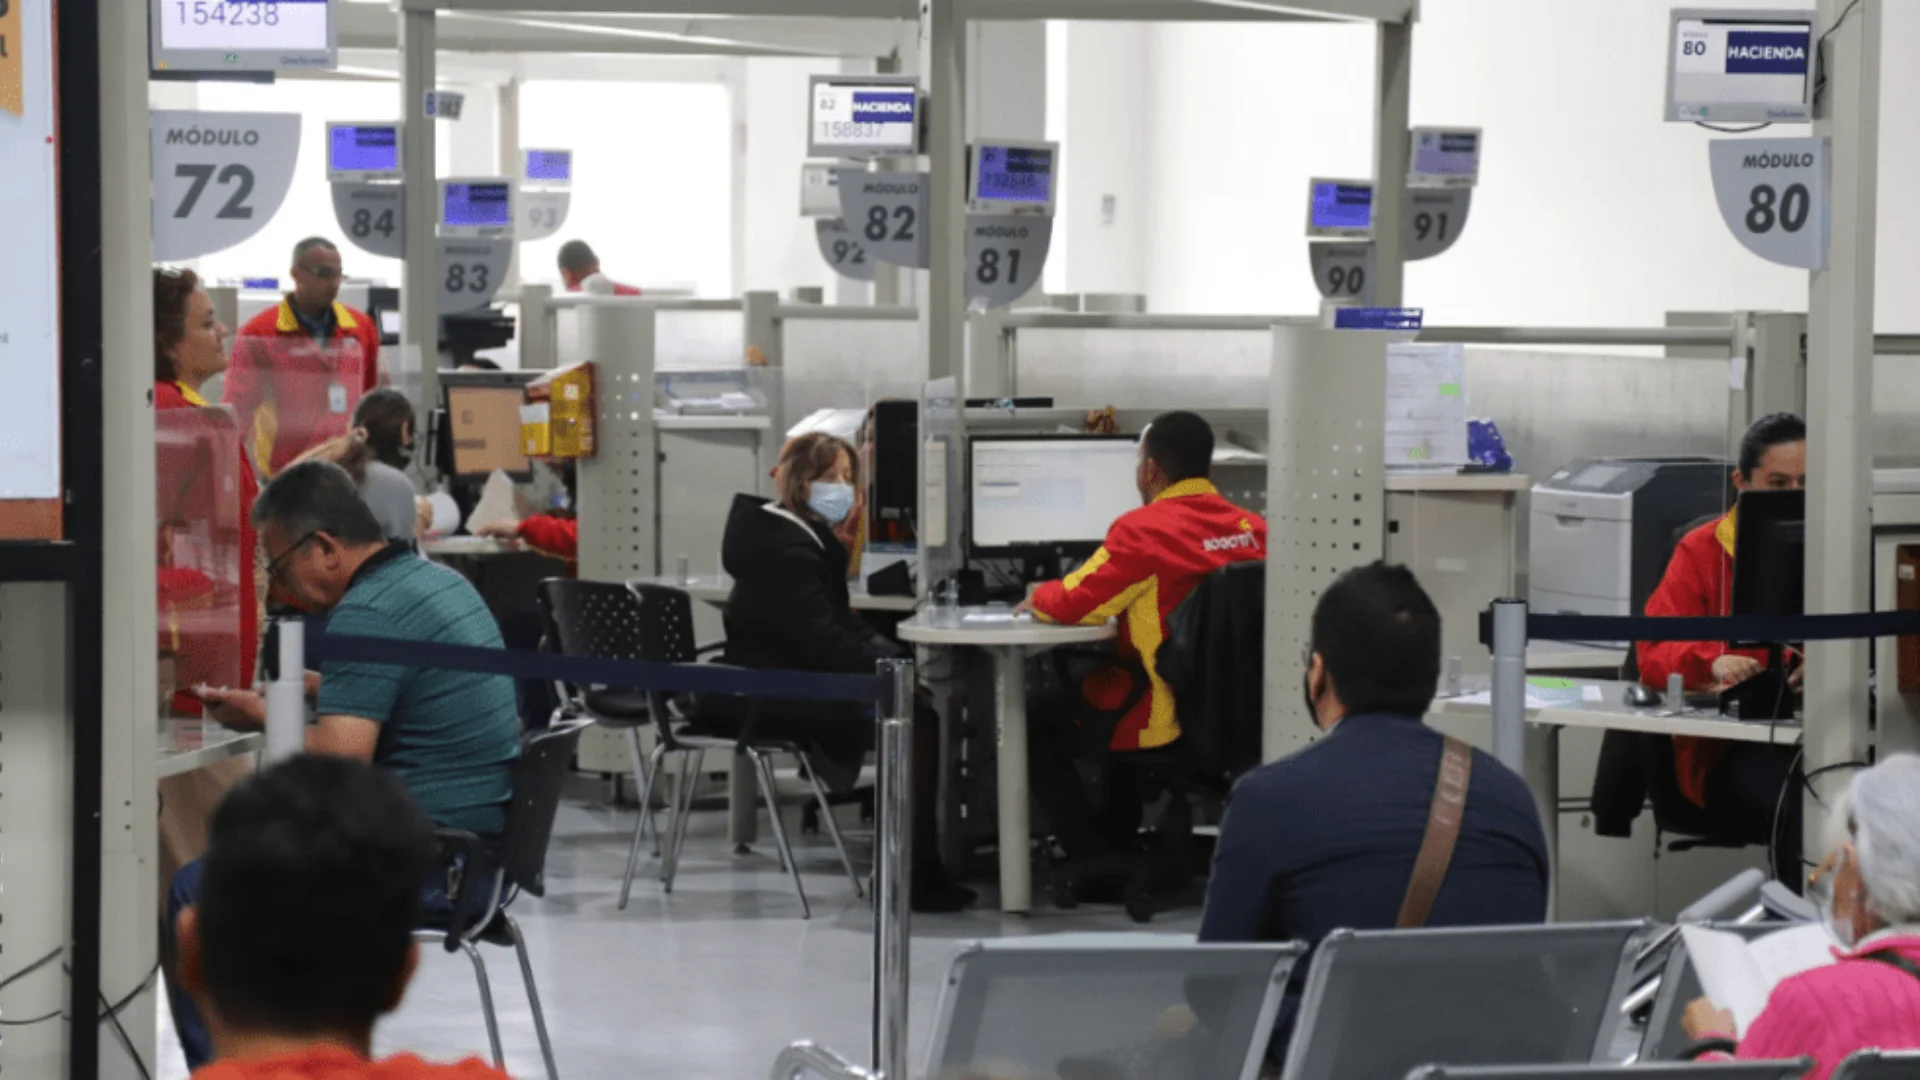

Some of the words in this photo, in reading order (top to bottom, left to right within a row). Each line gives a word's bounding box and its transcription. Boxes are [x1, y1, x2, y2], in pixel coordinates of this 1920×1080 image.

[176, 1, 279, 26] 154238
[1683, 40, 1706, 56] 80
[1728, 45, 1805, 59] HACIENDA
[820, 98, 835, 110] 82
[853, 102, 912, 112] HACIENDA
[165, 125, 260, 146] MÓDULO
[821, 121, 884, 138] 158837
[1742, 150, 1814, 169] MÓDULO
[173, 163, 255, 219] 72
[529, 208, 557, 229] 93
[1745, 182, 1811, 234] 80
[351, 208, 395, 238] 84
[864, 205, 915, 241] 82
[1414, 212, 1447, 241] 91
[444, 263, 489, 293] 83
[976, 248, 1021, 284] 81
[1329, 266, 1364, 295] 90
